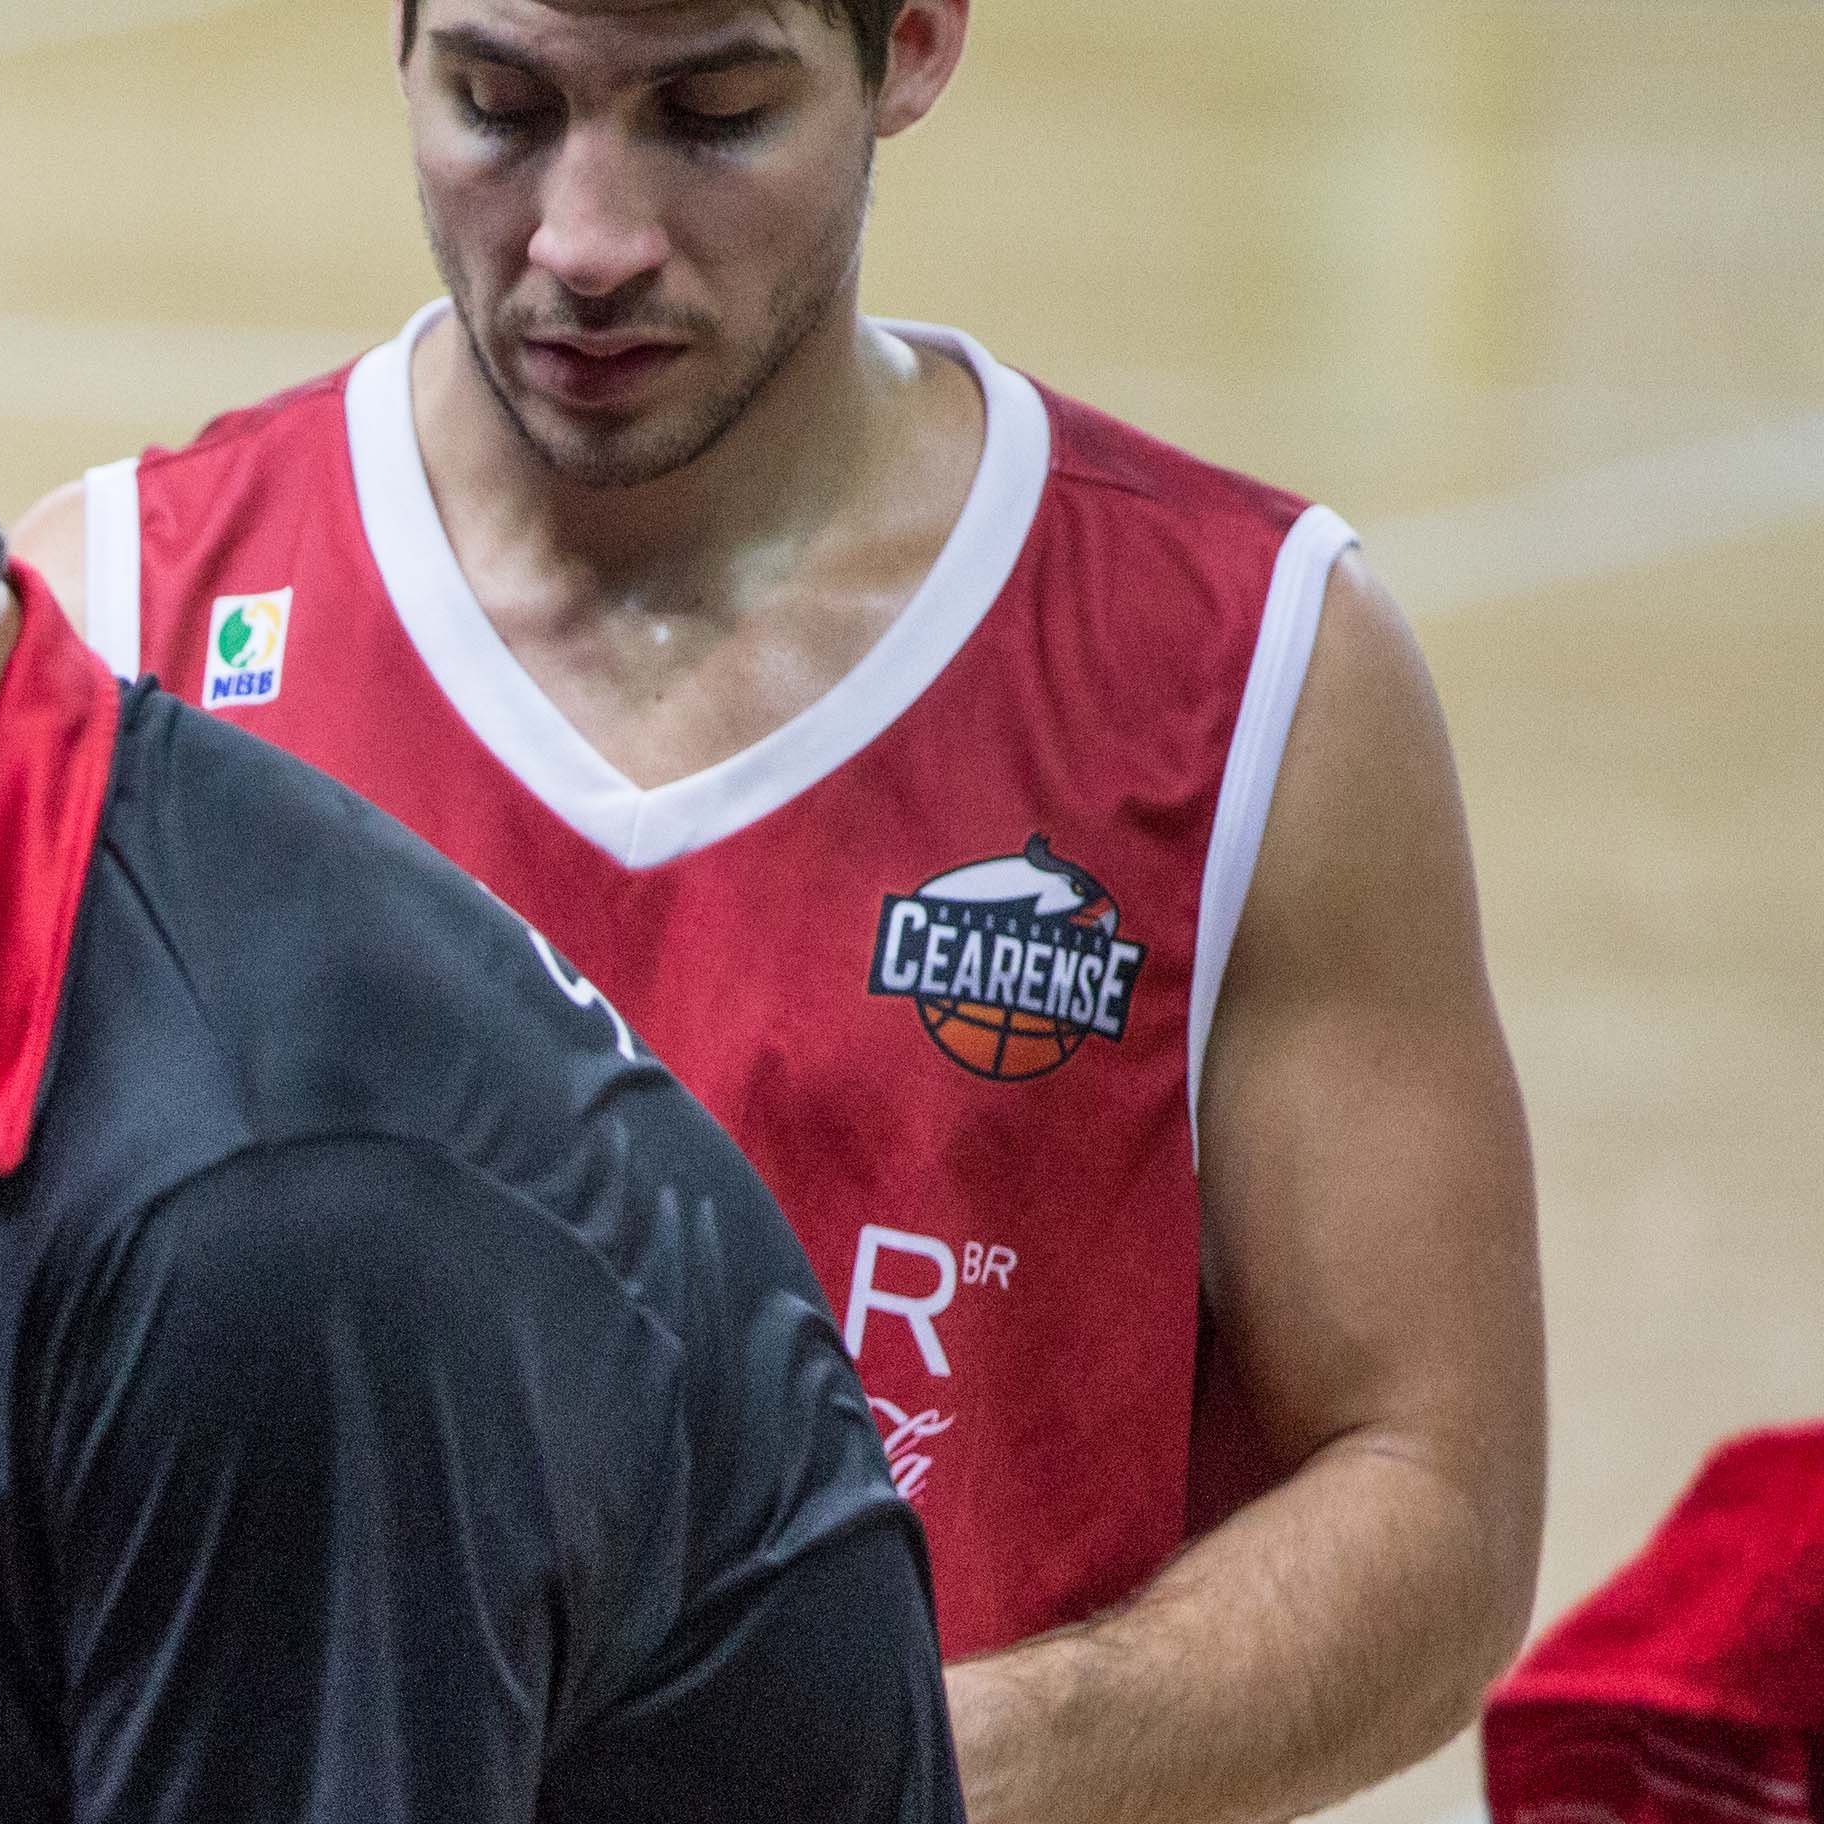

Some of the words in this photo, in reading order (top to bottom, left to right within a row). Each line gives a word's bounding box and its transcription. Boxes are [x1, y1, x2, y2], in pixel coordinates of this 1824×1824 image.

[211, 669, 274, 701] NBB
[880, 899, 1139, 1036] CEARENSE
[962, 1240, 1019, 1290] BR
